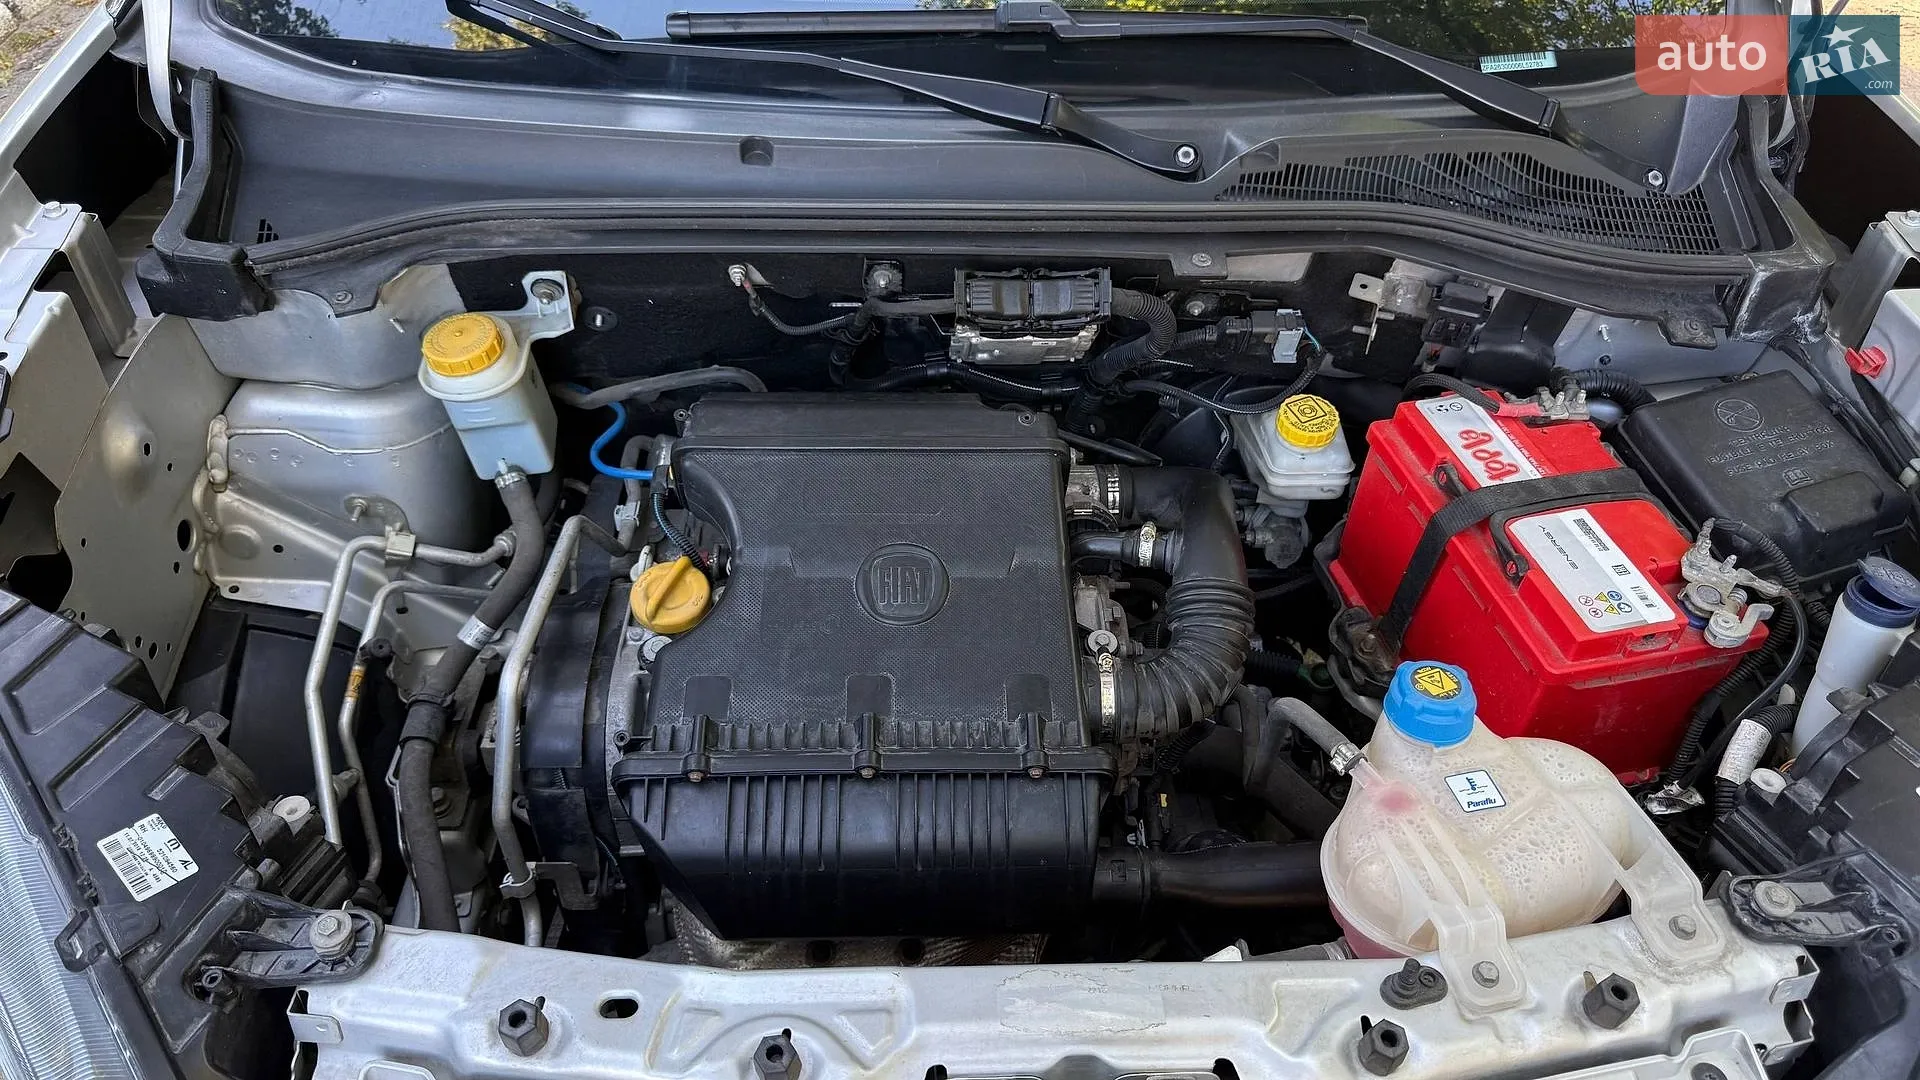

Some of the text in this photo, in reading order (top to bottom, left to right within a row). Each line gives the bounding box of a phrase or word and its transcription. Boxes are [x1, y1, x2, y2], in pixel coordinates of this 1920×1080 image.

[1538, 525, 1578, 570] ENERGY
[878, 566, 930, 604] FIAT
[1466, 798, 1496, 808] Paraflu
